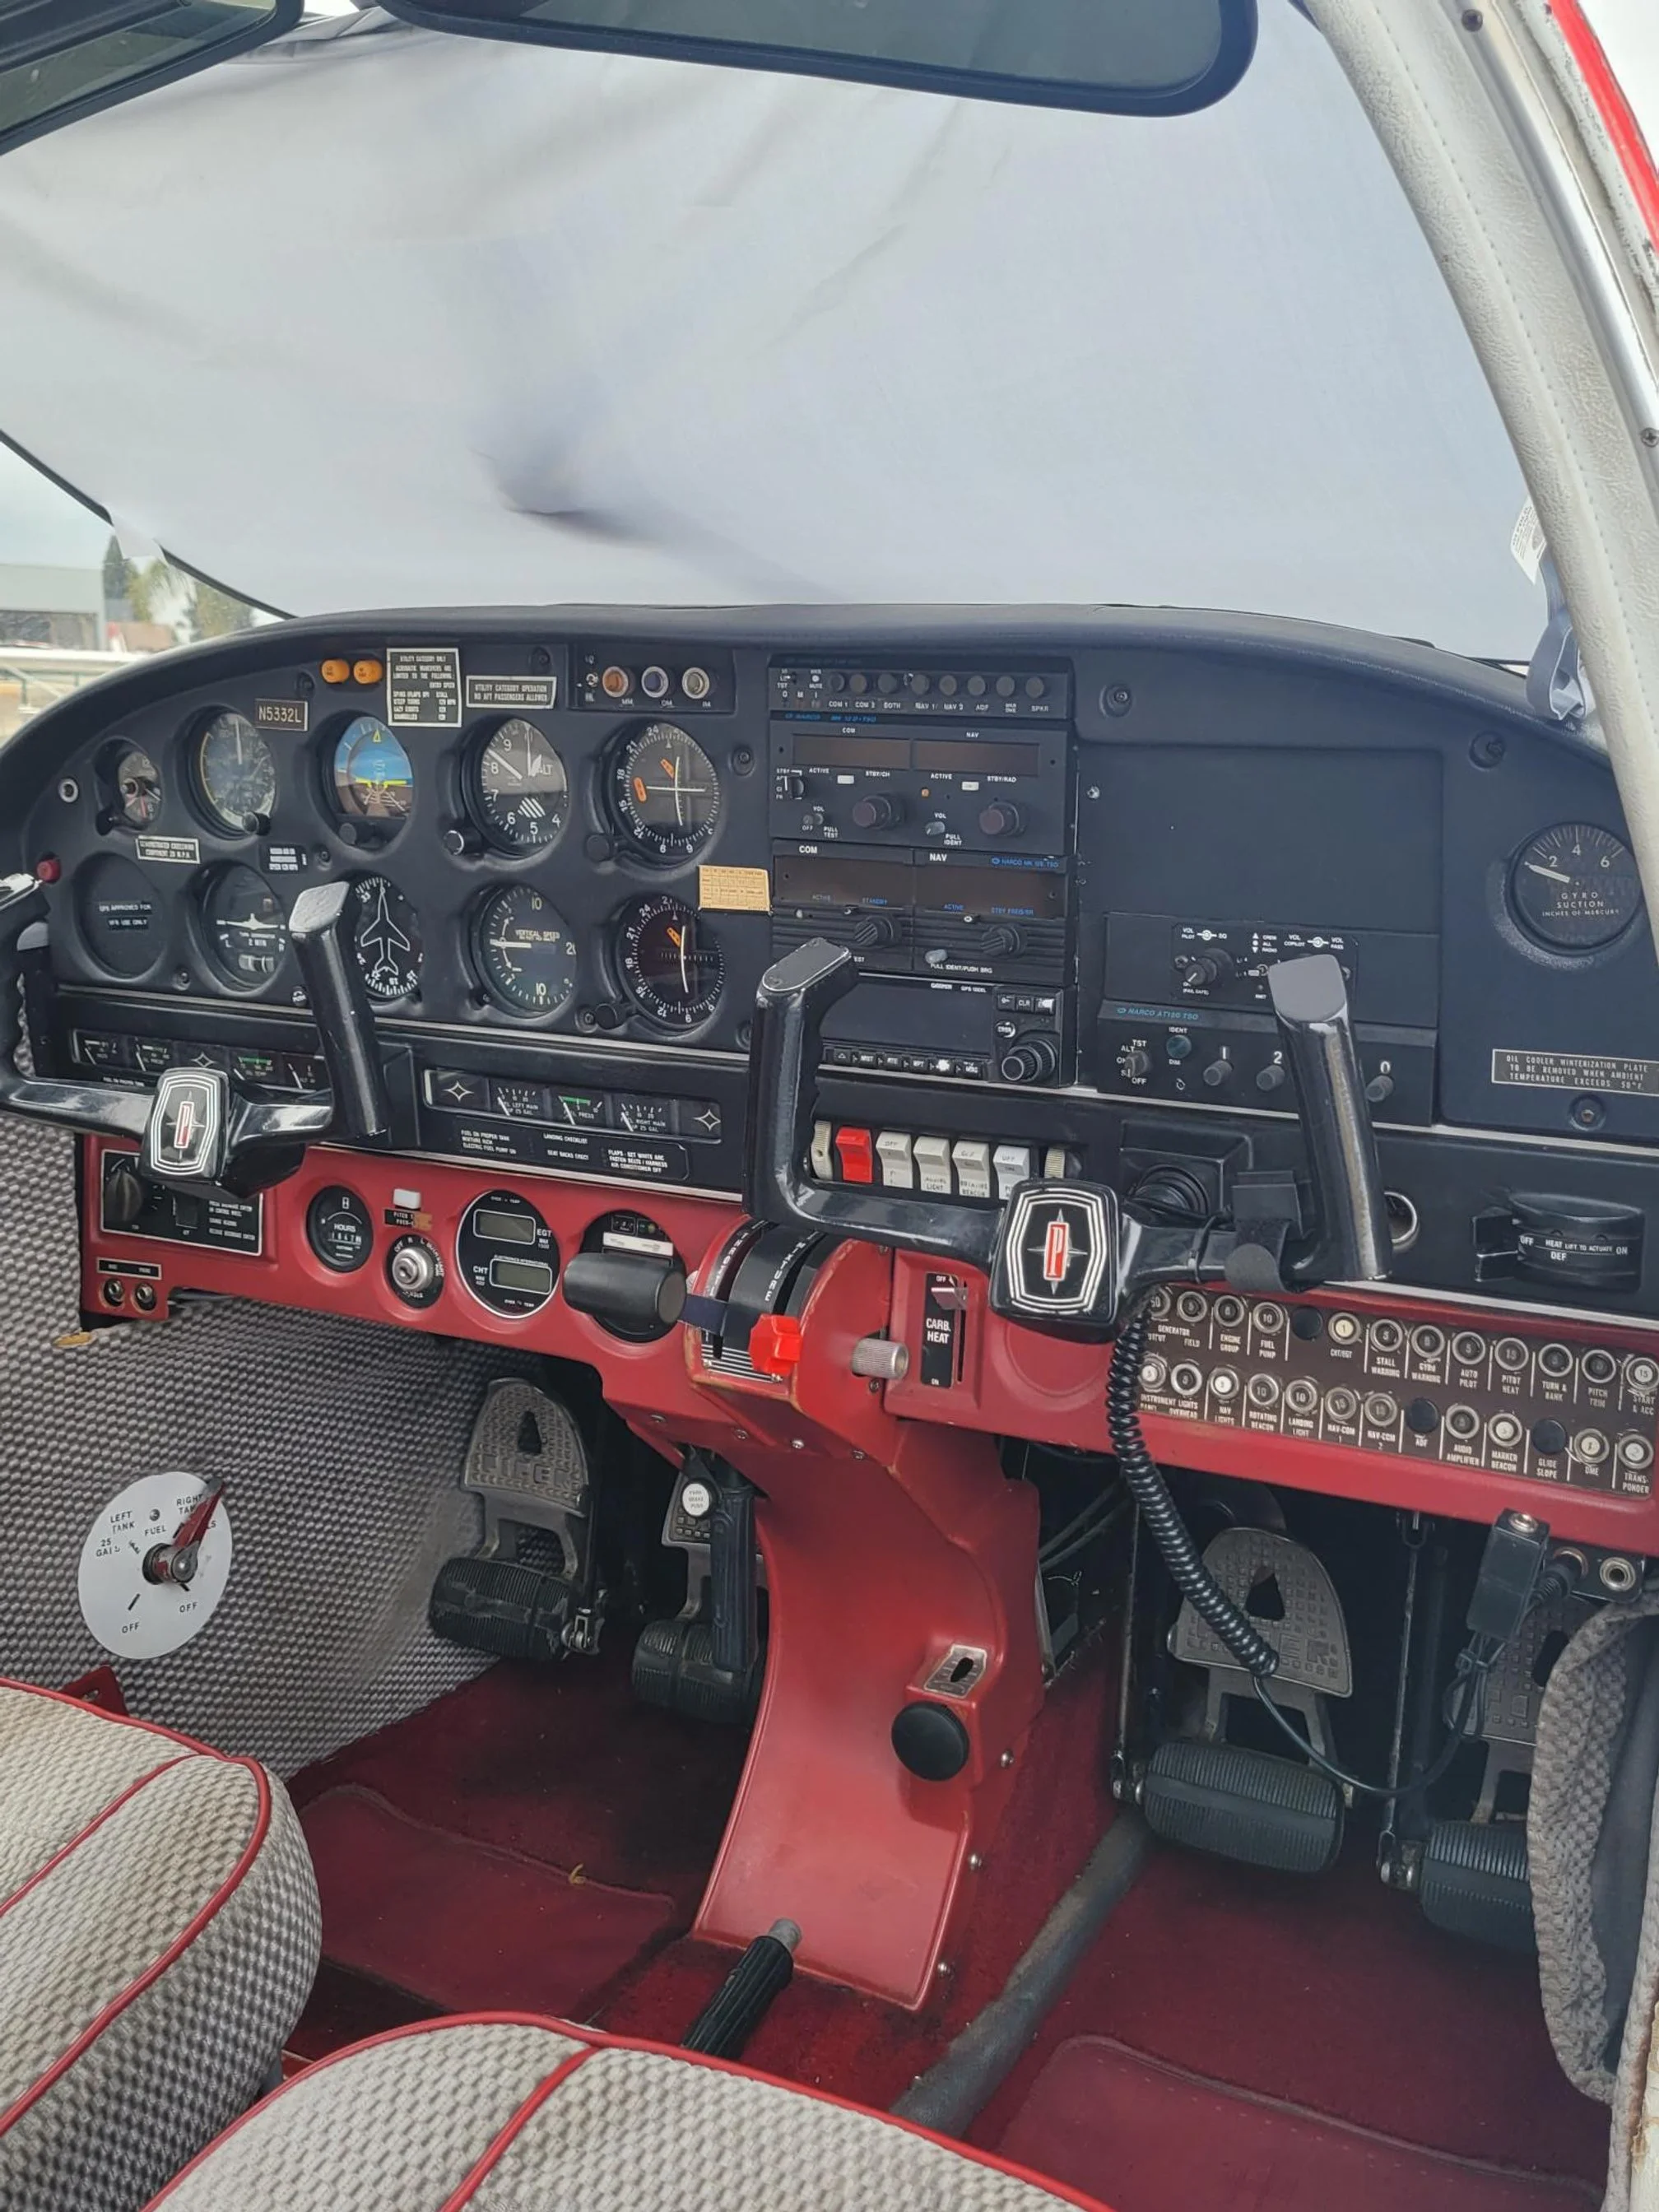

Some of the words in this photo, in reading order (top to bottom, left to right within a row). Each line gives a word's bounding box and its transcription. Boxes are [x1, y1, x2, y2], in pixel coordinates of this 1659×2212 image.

[258, 705, 302, 723] N5332L
[647, 725, 659, 736] 24
[503, 739, 512, 751] 9
[490, 763, 499, 774] 8
[490, 789, 499, 802] 7
[507, 812, 516, 825] 6
[552, 814, 560, 828] 4
[530, 822, 538, 834] 5
[798, 845, 818, 853] COM
[1571, 843, 1581, 856] 4
[929, 853, 947, 862] NAV
[1549, 856, 1558, 867] 2
[1600, 856, 1610, 868] 6
[532, 896, 542, 910] 10
[639, 904, 651, 917] 24
[536, 983, 546, 996] 10
[1128, 1008, 1156, 1016] NARCO
[1132, 1039, 1146, 1048] TST
[1273, 1051, 1283, 1064] 2
[1380, 1061, 1390, 1074] 0
[1527, 1057, 1554, 1065] COOLER
[1560, 1058, 1616, 1070] WINTERIZATION
[1624, 1063, 1647, 1072] PLATE
[1542, 1066, 1577, 1076] REMOVED
[1583, 1069, 1605, 1077] WHEN
[1610, 1071, 1644, 1080] AMBIENT
[1509, 1072, 1565, 1084] TEMPERATURE
[1574, 1077, 1610, 1087] EXCEEDS
[333, 1223, 356, 1233] HOURS
[537, 1229, 551, 1237] EGT
[1519, 1235, 1534, 1245] OFF
[1545, 1239, 1563, 1248] HEAT
[1615, 1246, 1628, 1255] ON
[1550, 1251, 1567, 1261] DEF
[764, 1241, 806, 1301] MIXTURE
[1262, 1314, 1273, 1323] 10
[926, 1317, 951, 1331] CARB.
[1157, 1324, 1190, 1336] GENERATOR
[927, 1331, 950, 1344] HEAT
[1220, 1334, 1241, 1344] ENGINE
[1382, 1331, 1388, 1341] 5
[1184, 1338, 1200, 1347] FIELD
[1261, 1340, 1275, 1349] FUEL
[1220, 1344, 1239, 1352] GROUP
[1259, 1350, 1276, 1359] PUMP
[1377, 1357, 1395, 1367] STALL
[1371, 1367, 1400, 1378] WARNING
[1419, 1363, 1436, 1372] GYRO
[1411, 1373, 1441, 1383] WARNING
[1461, 1369, 1478, 1378] AUTO
[1459, 1378, 1477, 1388] PILOT
[1501, 1375, 1521, 1385] PITOT
[1542, 1381, 1559, 1389] TURN
[1257, 1387, 1266, 1396] 10
[1503, 1385, 1519, 1395] HEAT
[1588, 1387, 1608, 1397] PITCH
[1295, 1392, 1305, 1402] 10
[1545, 1392, 1563, 1401] BANK
[1633, 1396, 1656, 1406] START
[1178, 1399, 1198, 1409] LIGHTS
[1589, 1398, 1606, 1407] TRIM
[1169, 1408, 1197, 1419] OVERHEAD
[1640, 1406, 1655, 1415] ACC
[1249, 1411, 1277, 1422] ROTATING
[1251, 1421, 1274, 1431] BEACON
[1289, 1418, 1313, 1428] LANDING
[1292, 1428, 1309, 1437] LIGHT
[1327, 1424, 1355, 1435] NAV-COM
[1378, 1442, 1382, 1450] 2
[1415, 1438, 1428, 1448] ADF
[1453, 1444, 1472, 1454] AUDIO
[1446, 1453, 1480, 1466] AMPLIFIER
[1491, 1451, 1518, 1462] MARKER
[1491, 1461, 1517, 1471] BEACON
[1538, 1458, 1558, 1468] GLIDE
[1536, 1468, 1557, 1479] SLOPE
[1585, 1466, 1599, 1475] DME
[1622, 1483, 1649, 1494] PONDER
[176, 1494, 202, 1506] RIGHT
[110, 1510, 132, 1523] LEFT
[112, 1522, 135, 1533] TANK
[145, 1526, 167, 1536] FUEL
[100, 1539, 112, 1547] 25
[179, 1602, 198, 1613] OFF
[122, 1622, 140, 1633] OFF
